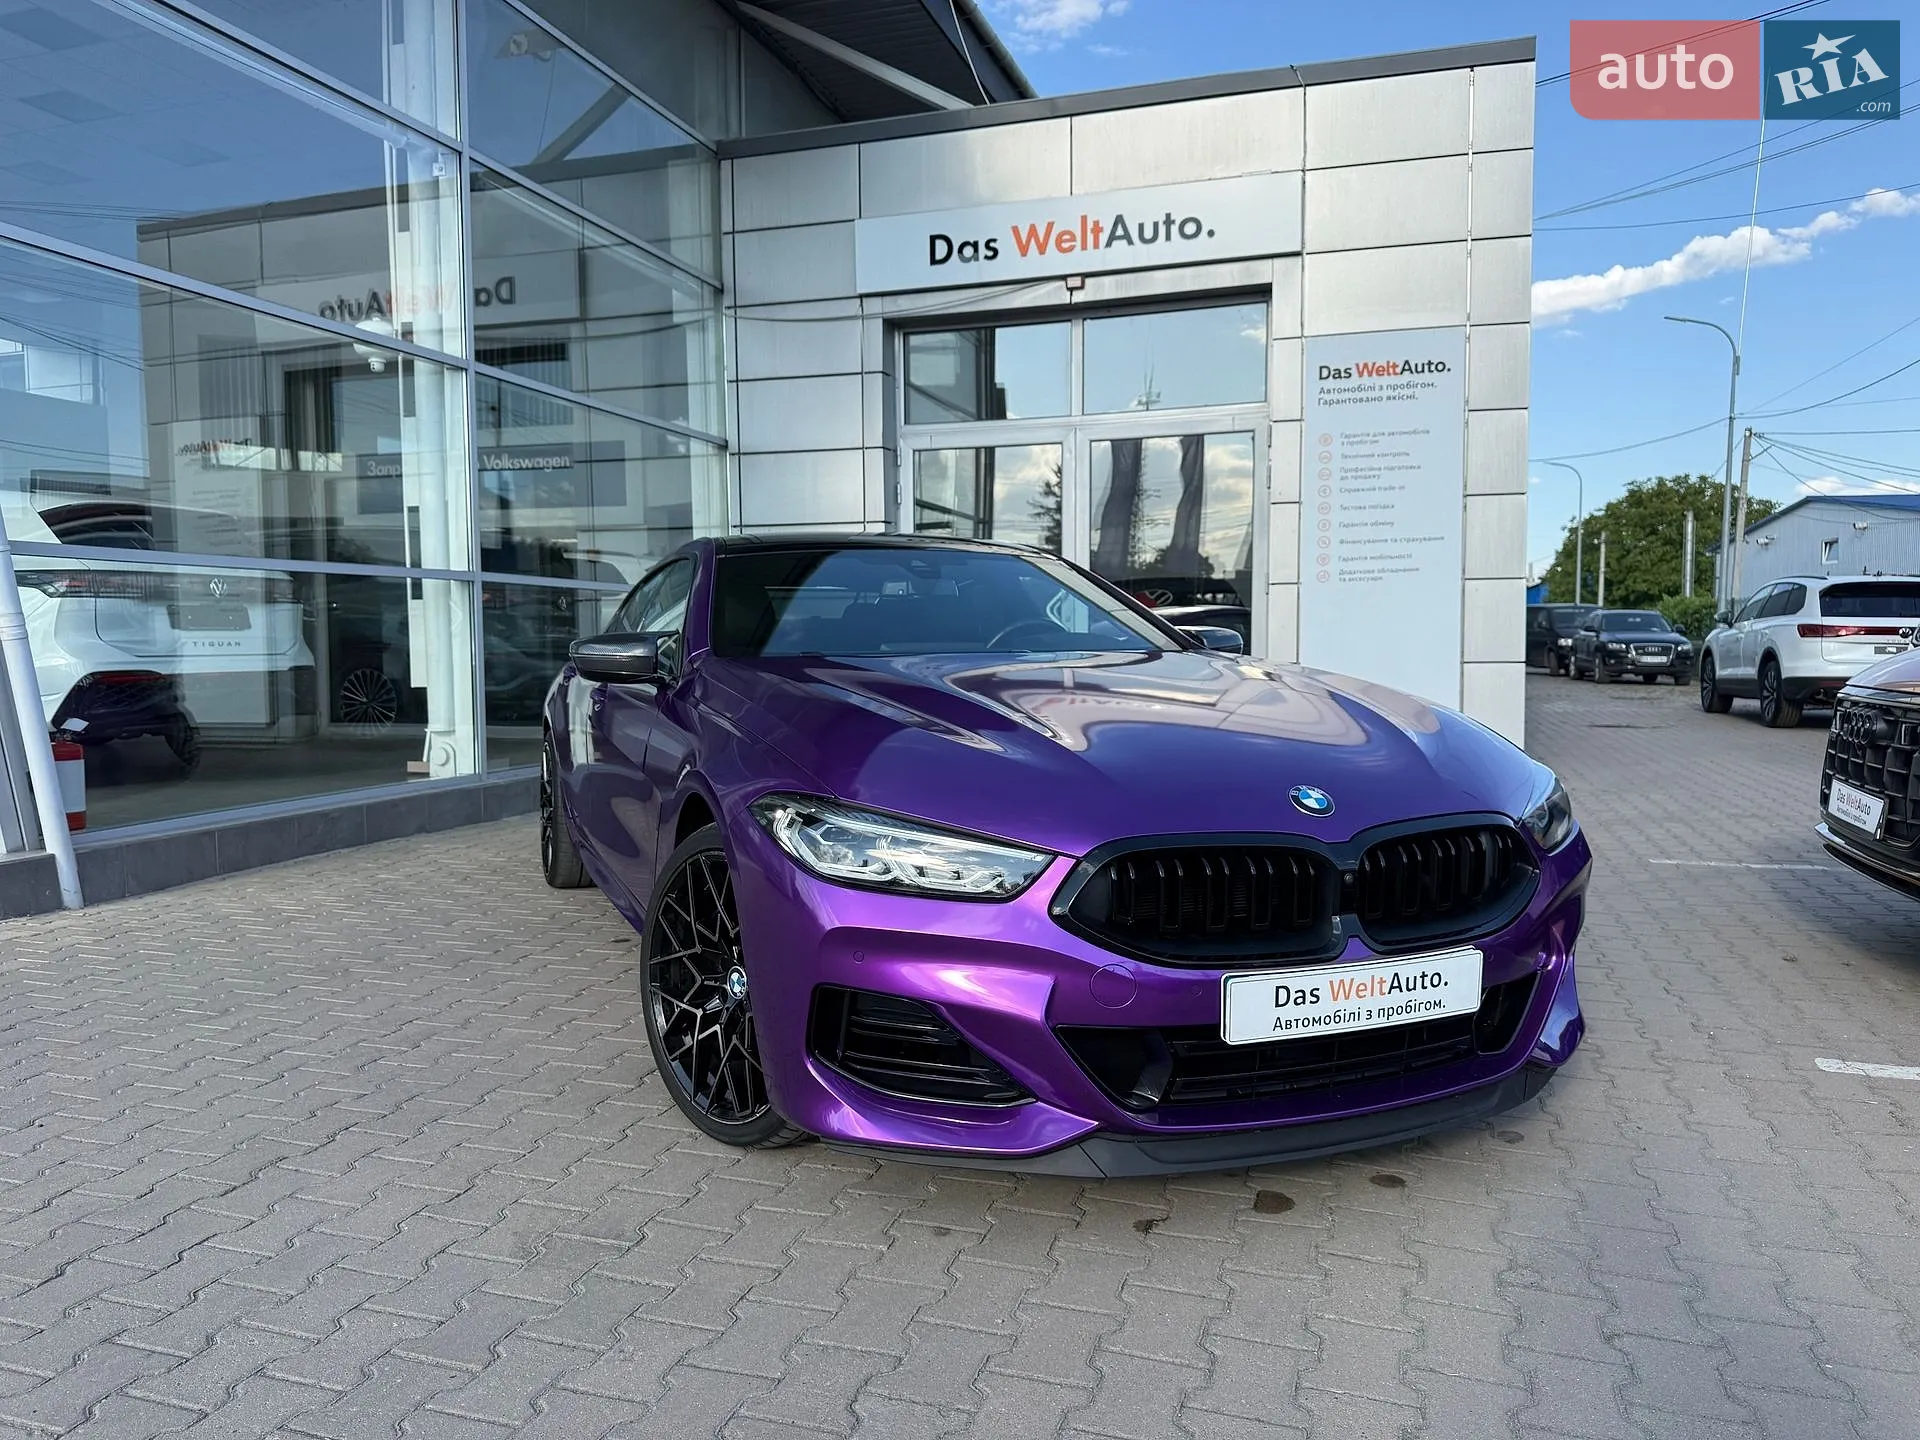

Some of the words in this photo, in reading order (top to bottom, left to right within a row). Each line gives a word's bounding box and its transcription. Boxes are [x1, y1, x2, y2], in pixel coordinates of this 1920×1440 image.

[929, 234, 999, 266] Das
[1011, 212, 1215, 257] WeltAuto.
[1319, 364, 1352, 381] Das
[1355, 359, 1452, 378] WeltAuto.
[1319, 383, 1376, 395] Автомобілі
[1378, 384, 1383, 392] з
[1386, 380, 1438, 392] пробігом.
[1318, 396, 1383, 407] Гарантовано
[1386, 391, 1418, 401] якісні.
[483, 455, 570, 472] Volkswagen
[1274, 985, 1320, 1008] Das
[1329, 971, 1448, 1002] WeltAuto.
[1273, 1008, 1361, 1032] Автомобілі
[1365, 1007, 1372, 1020] з
[1377, 998, 1446, 1021] пробігом.
